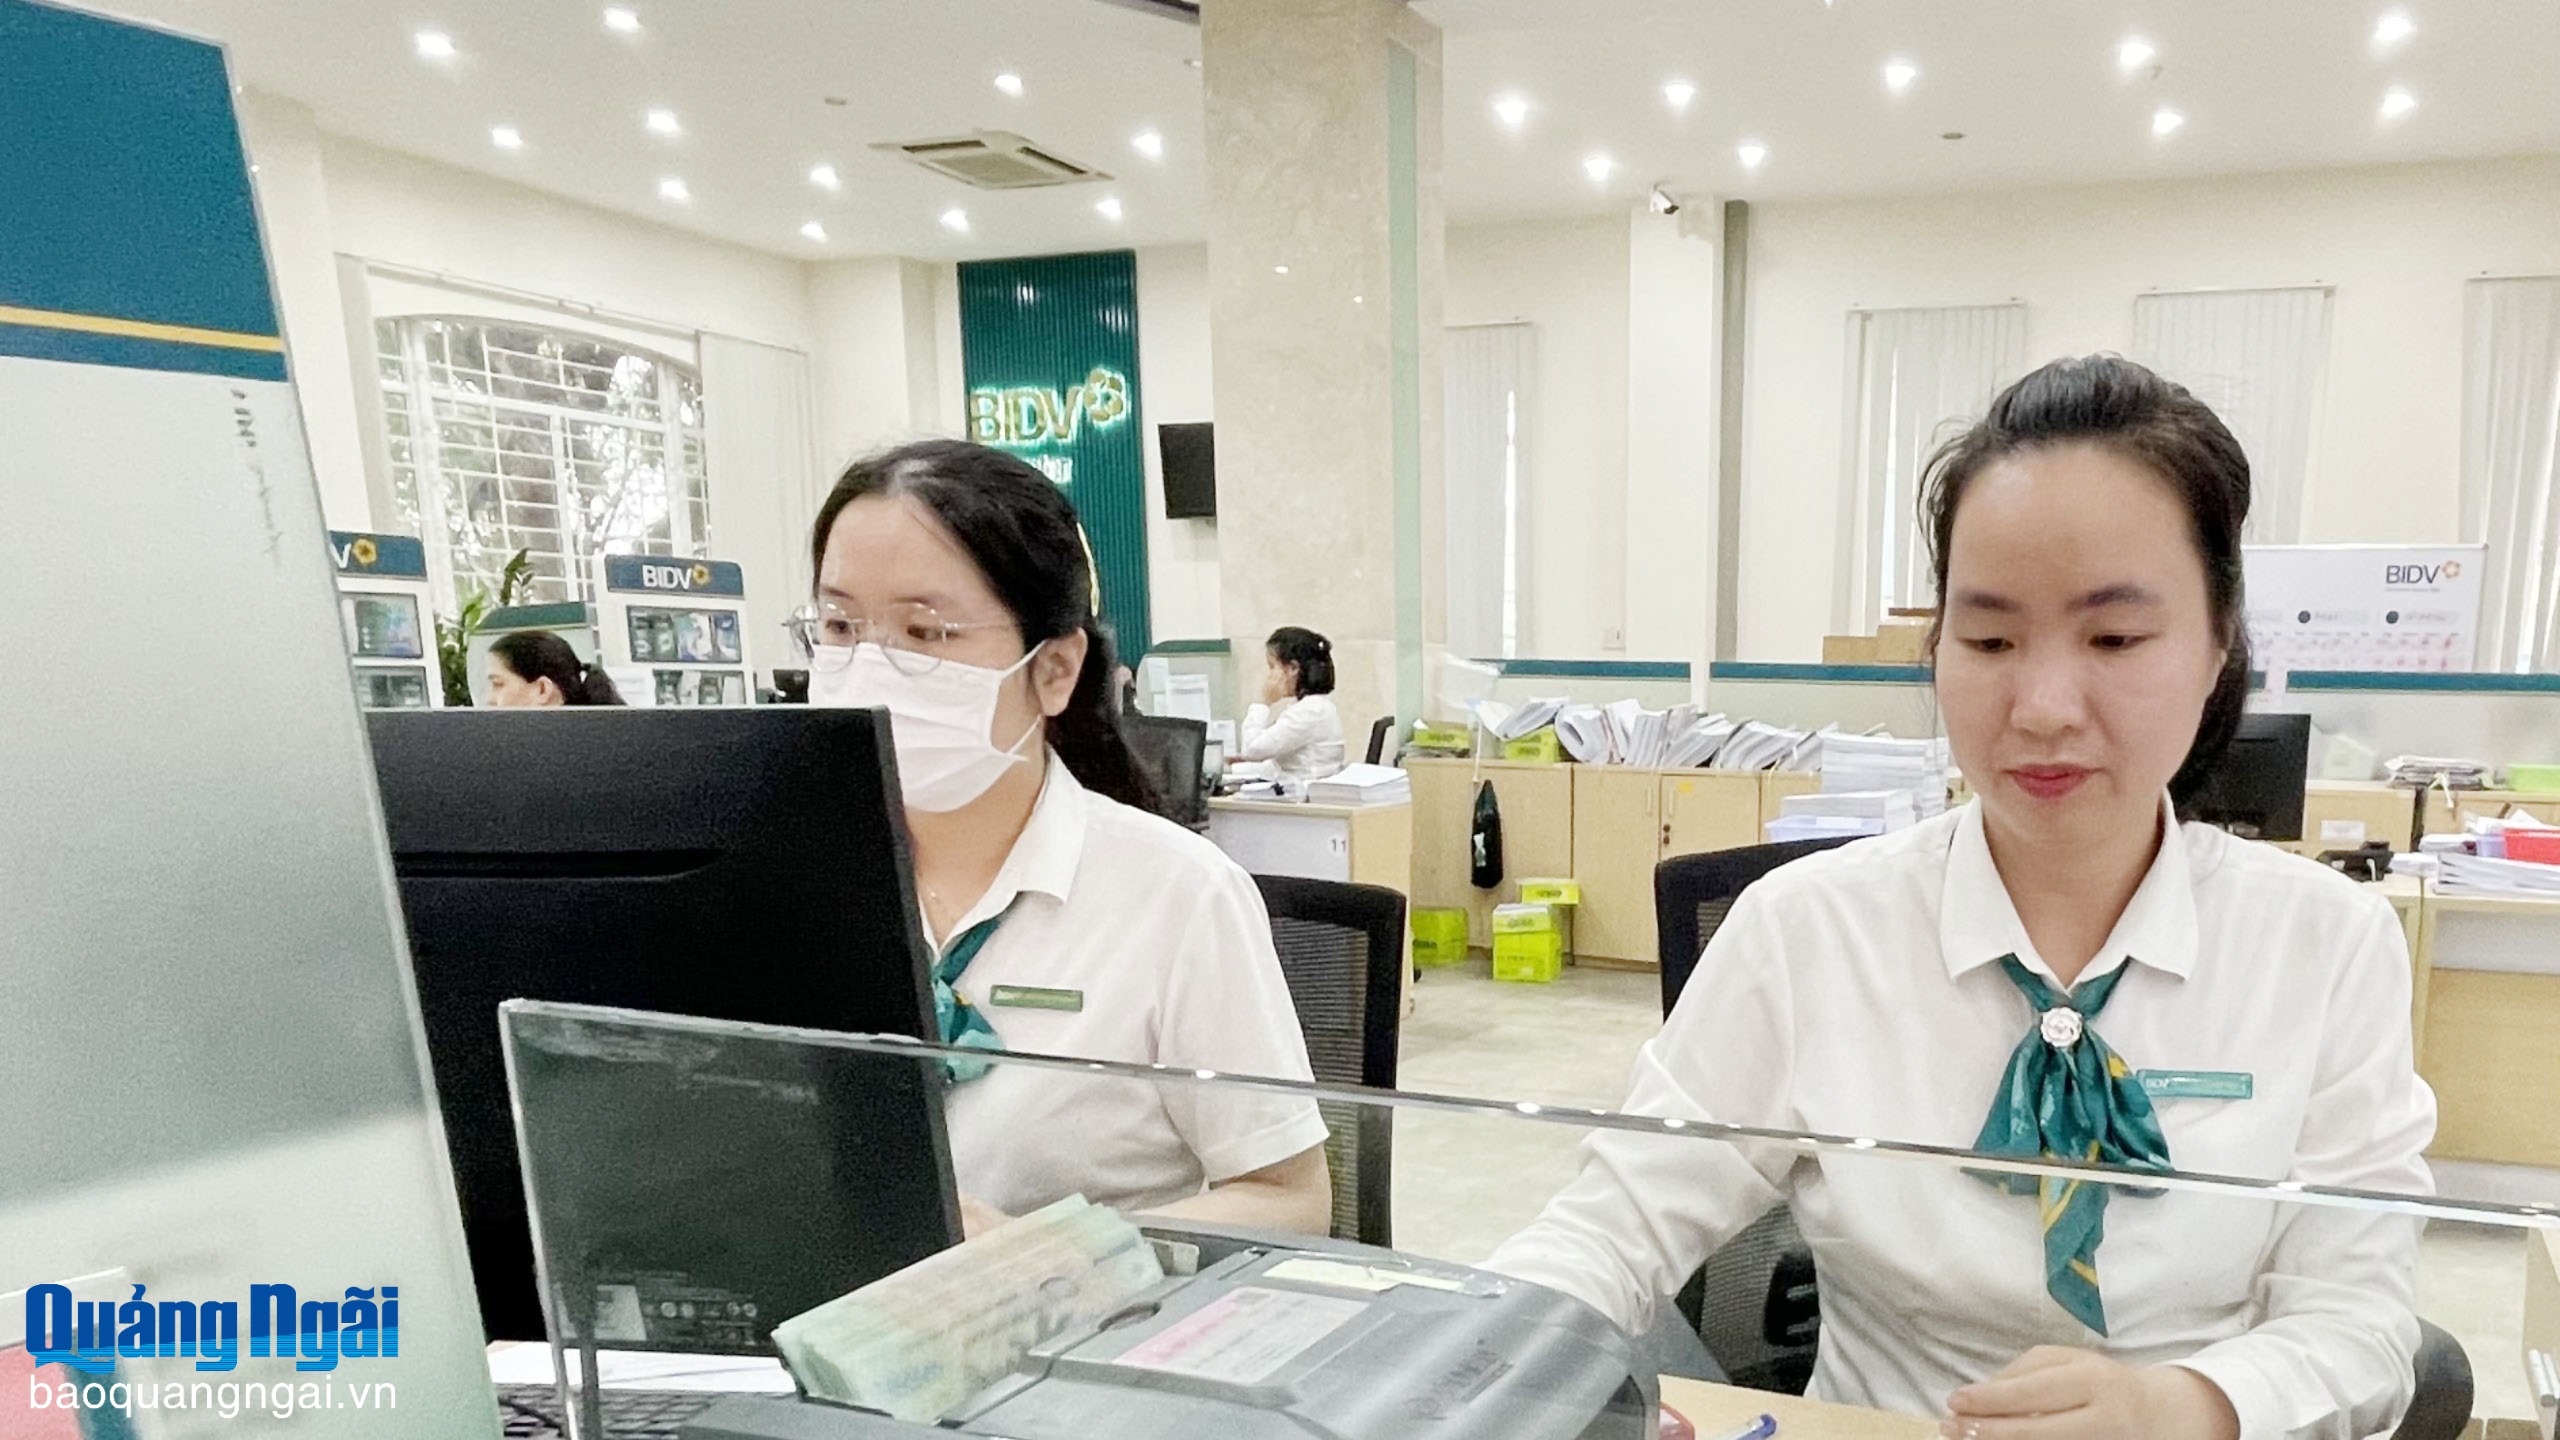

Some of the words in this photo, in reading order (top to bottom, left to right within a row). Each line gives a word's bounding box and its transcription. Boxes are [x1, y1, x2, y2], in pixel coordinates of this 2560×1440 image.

[970, 386, 1082, 443] BIDV
[642, 564, 692, 590] BIDV
[2386, 564, 2440, 584] BIDV
[1331, 838, 1347, 853] 11
